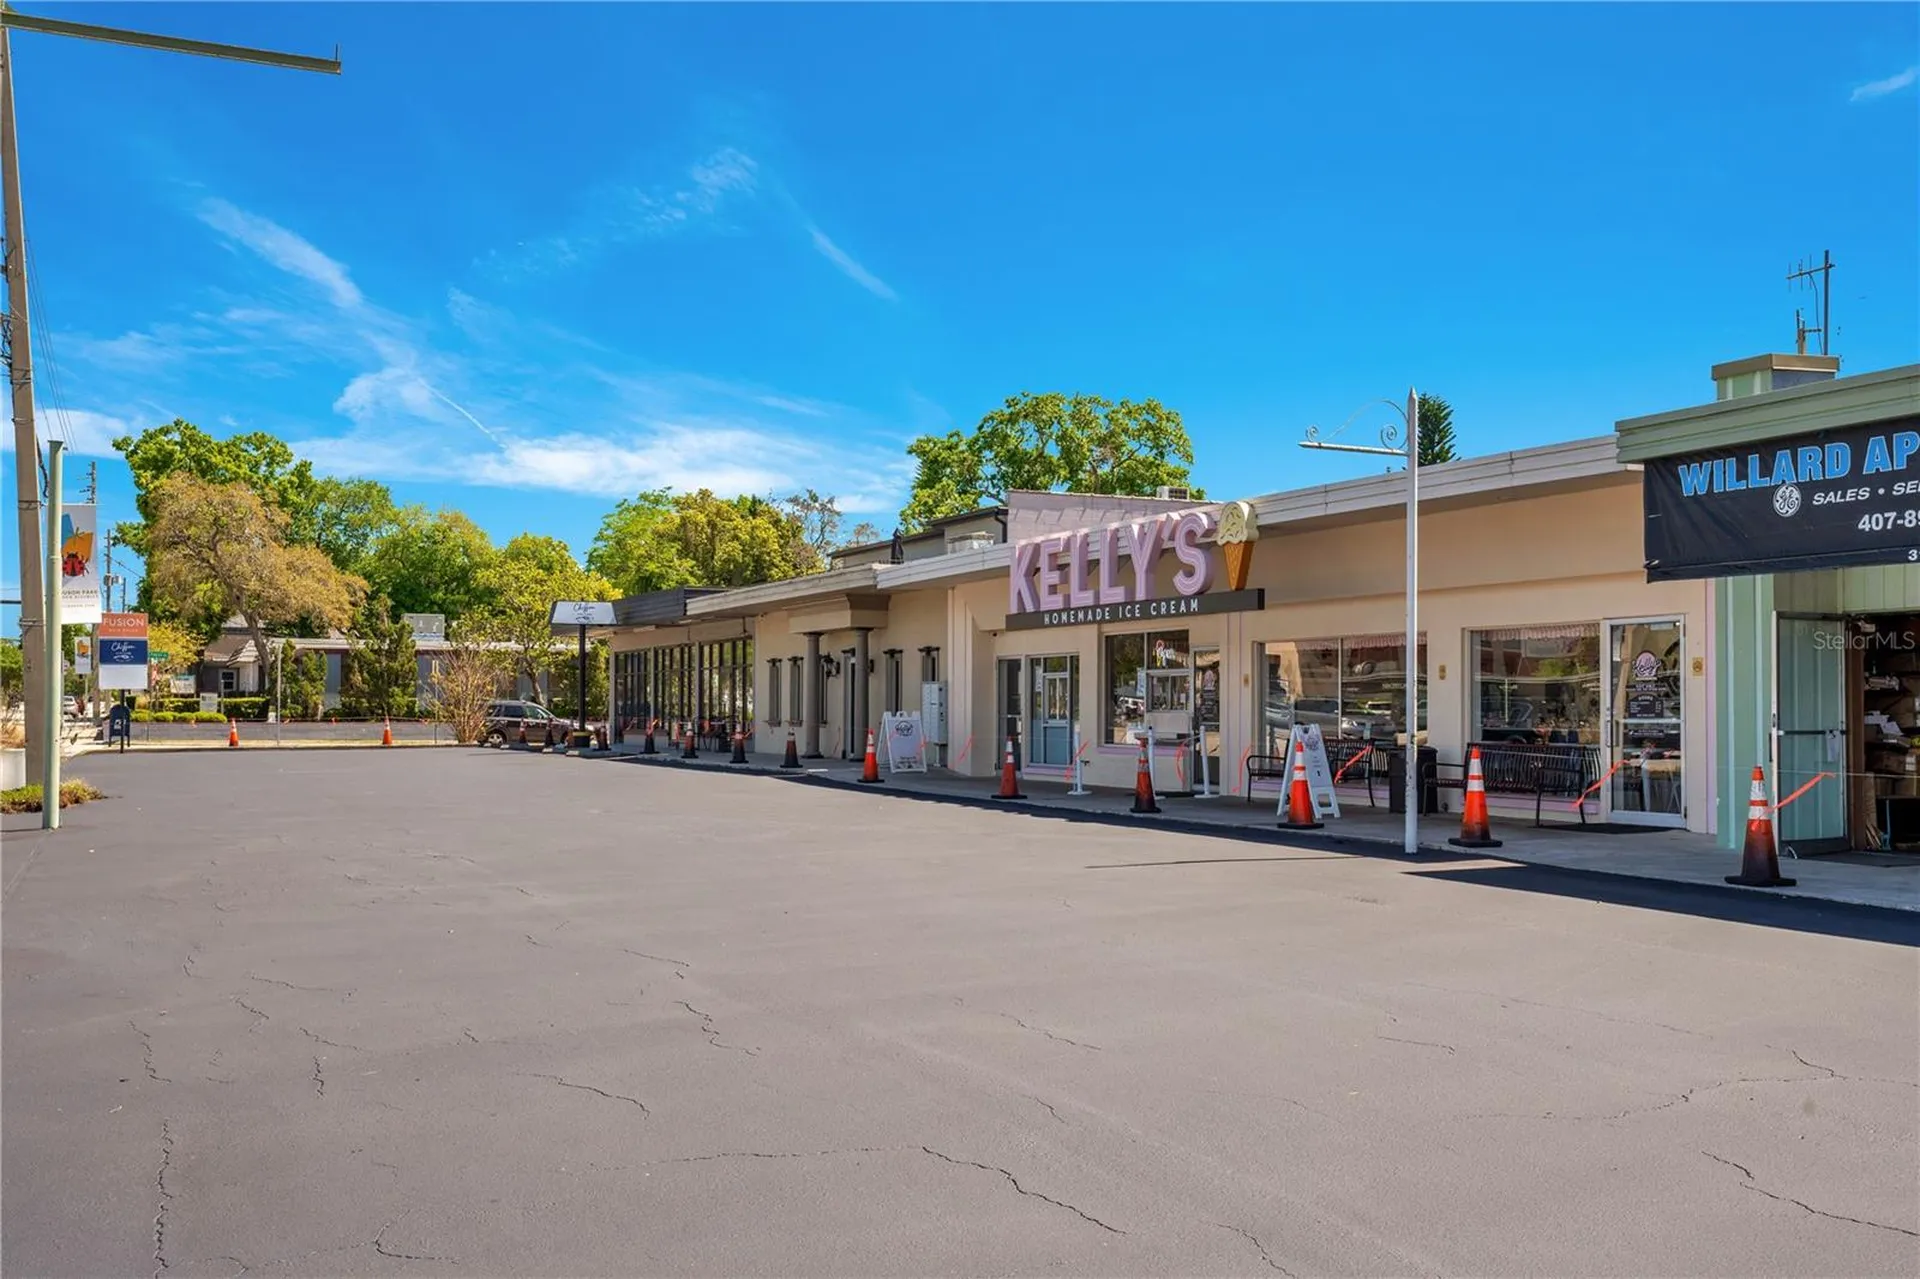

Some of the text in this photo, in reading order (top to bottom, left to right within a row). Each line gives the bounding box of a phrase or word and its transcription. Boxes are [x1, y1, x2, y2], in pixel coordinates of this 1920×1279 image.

[1677, 431, 1920, 497] WILLARD AP
[1812, 480, 1920, 506] SALES SE
[1858, 509, 1920, 532] 407-8
[1009, 510, 1217, 615] KELLY'S
[103, 617, 145, 627] FUSION
[1044, 599, 1200, 626] HOMEMADE ICE CREAM
